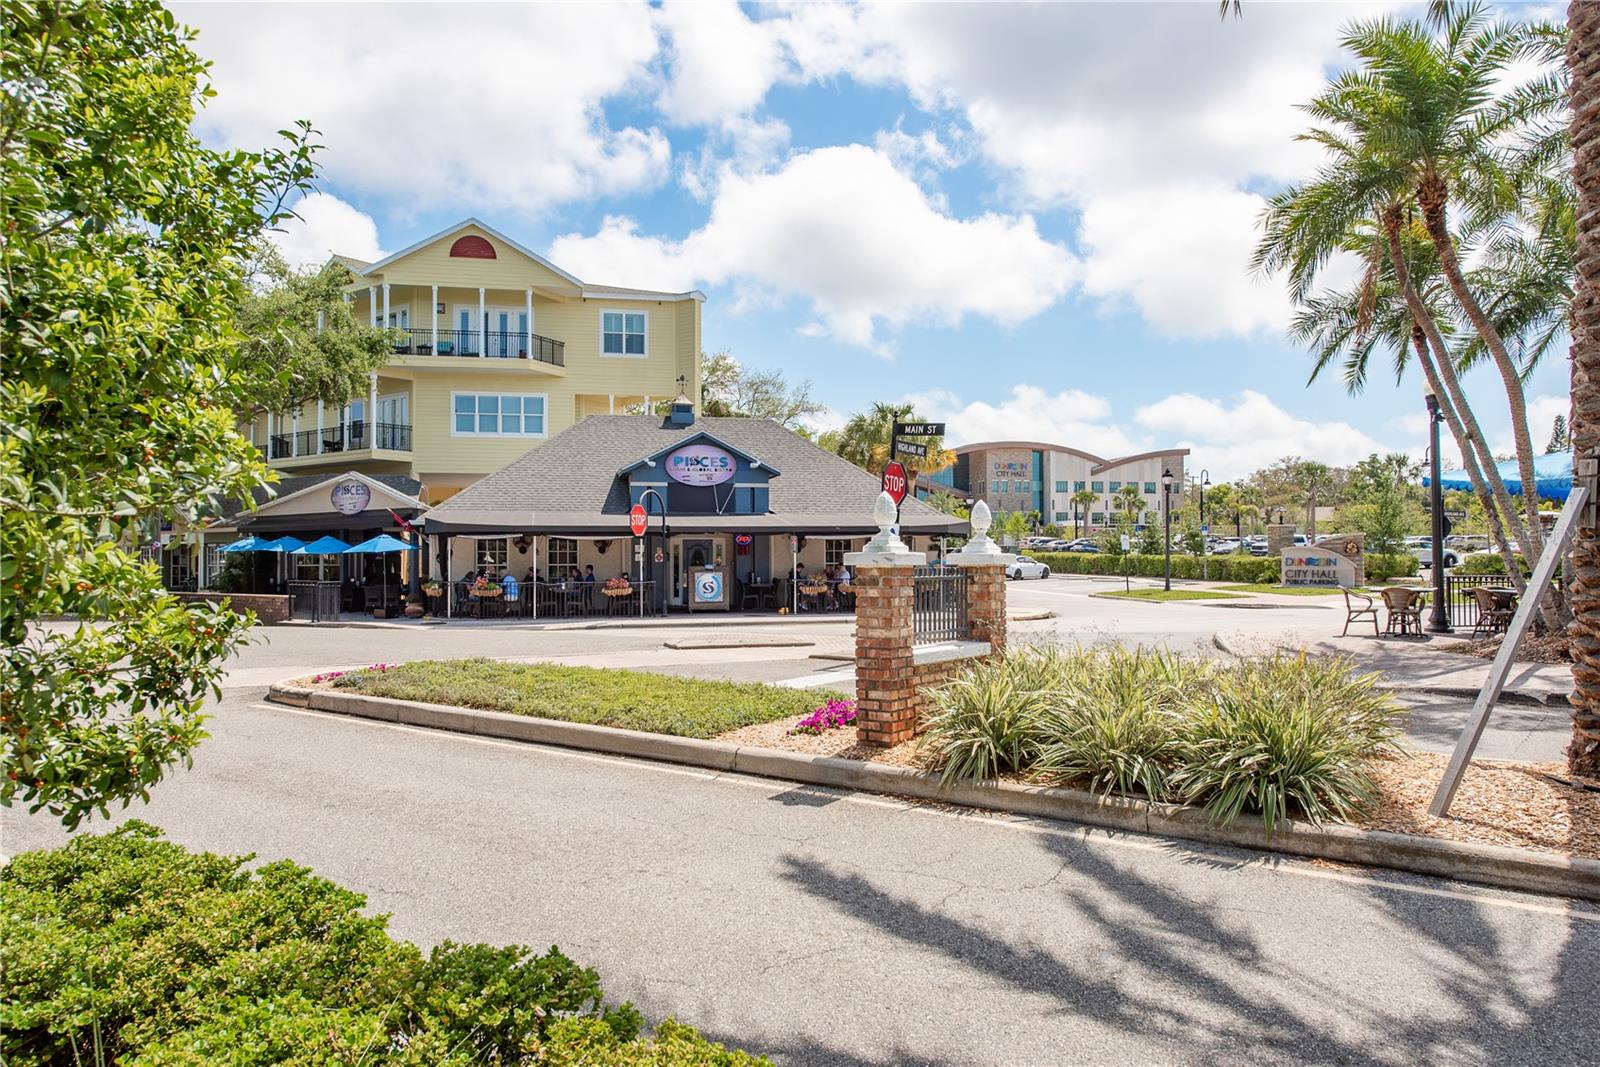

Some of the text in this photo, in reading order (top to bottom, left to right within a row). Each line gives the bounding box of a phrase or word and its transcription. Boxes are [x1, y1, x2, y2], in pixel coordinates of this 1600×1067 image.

[905, 425, 937, 434] MAIN ST
[897, 442, 925, 456] HIGHLAND AVE
[673, 456, 728, 467] PISCES
[884, 474, 904, 493] STOP
[335, 485, 365, 496] PISCES
[631, 514, 646, 526] STOP
[1285, 569, 1339, 578] CITY HALL
